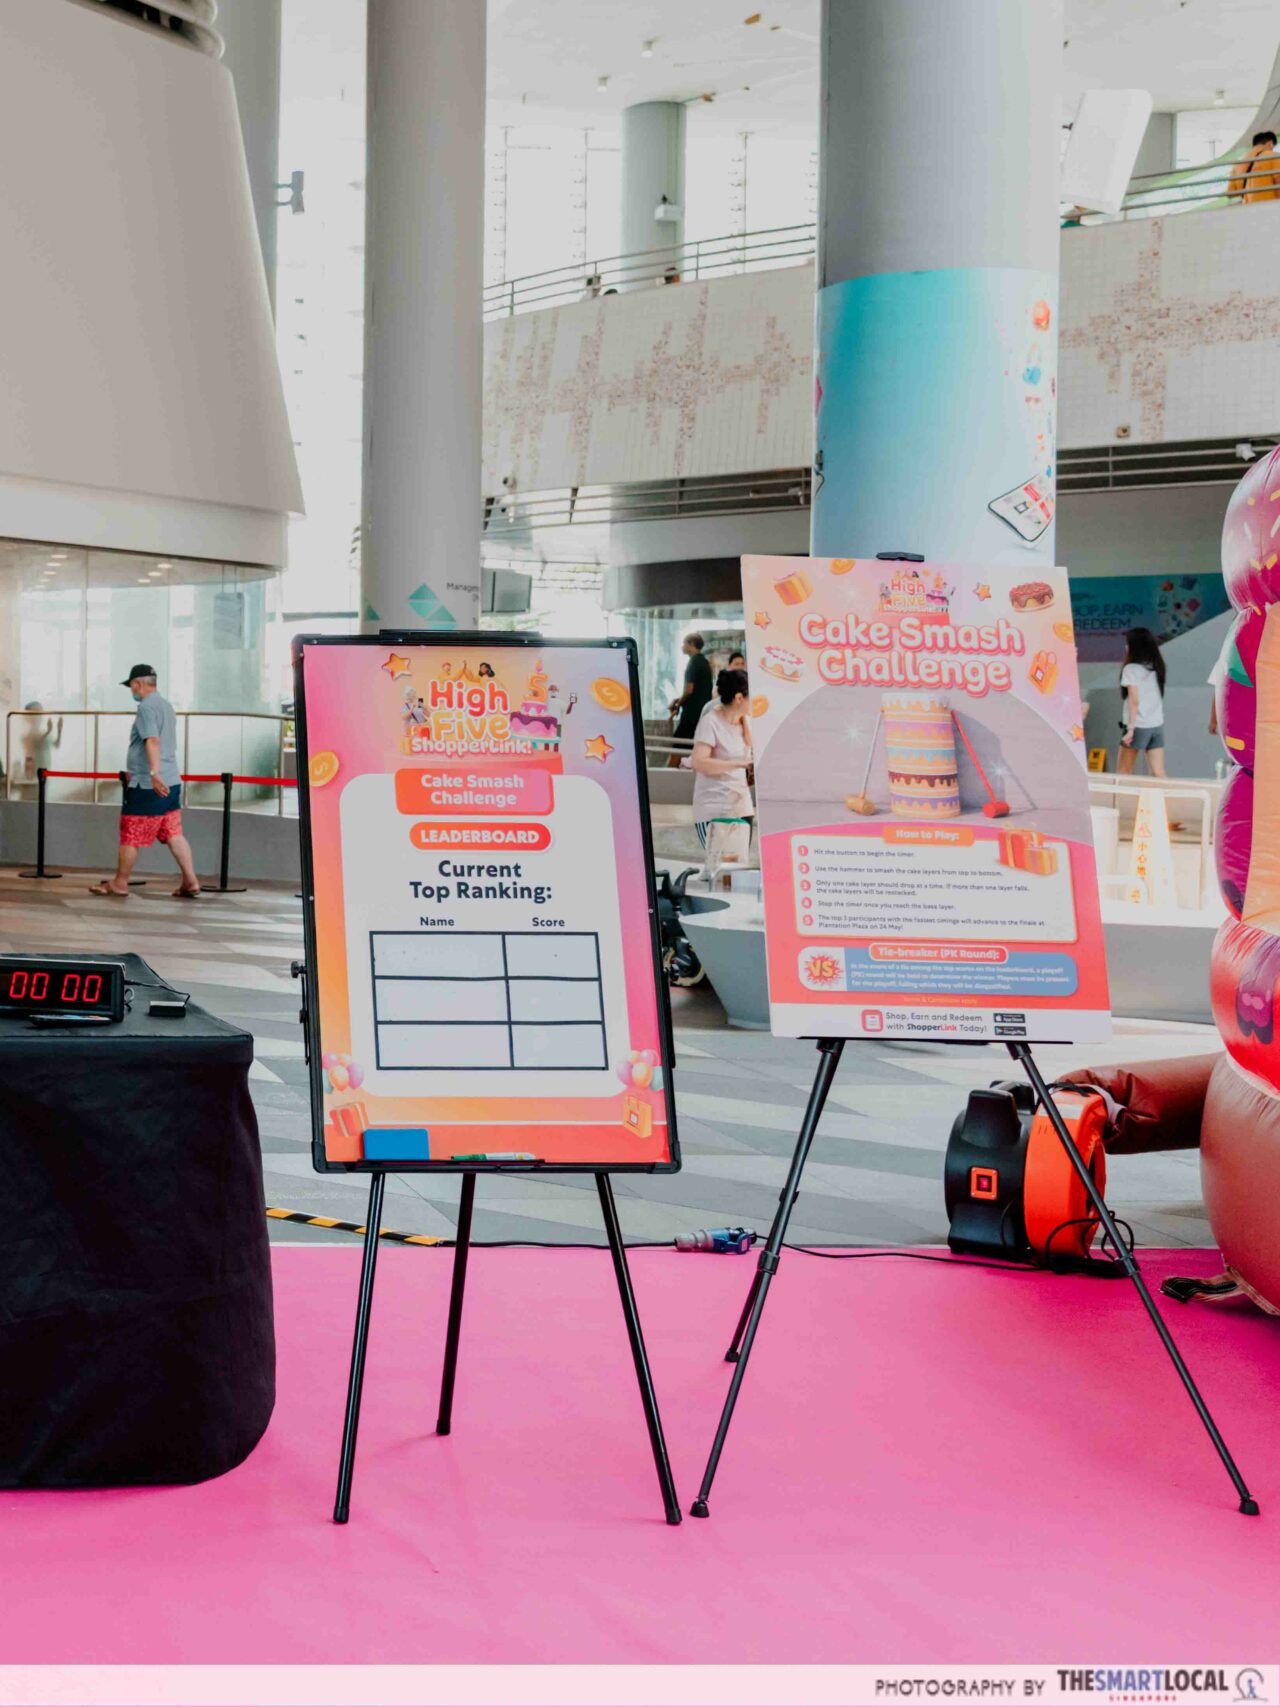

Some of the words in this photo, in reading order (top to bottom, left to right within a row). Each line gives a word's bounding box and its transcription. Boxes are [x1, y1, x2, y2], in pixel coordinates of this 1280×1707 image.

[891, 580, 926, 595] High
[1104, 604, 1144, 616] EARN
[800, 614, 890, 646] Cake
[899, 617, 1022, 652] Smash
[819, 650, 1010, 693] Challenge
[430, 680, 509, 717] High
[432, 711, 510, 741] Five
[411, 738, 532, 757] ShopperLink!
[421, 774, 463, 789] Cake
[467, 774, 524, 789] Smash
[430, 790, 517, 807] Challenge
[421, 829, 540, 844] LEADERBOARD
[895, 829, 919, 839] How
[921, 831, 932, 839] to
[438, 860, 522, 877] Current
[409, 881, 451, 903] Top
[456, 881, 553, 903] Ranking:
[420, 917, 455, 927] Name
[532, 917, 565, 927] Score
[808, 959, 833, 977] VS
[9, 971, 50, 999] 00
[61, 973, 102, 1002] 00
[911, 1012, 930, 1020] Earn
[931, 1013, 948, 1021] and
[949, 1014, 983, 1022] Redeem
[887, 1023, 905, 1031] with
[907, 1023, 957, 1032] ShopperLink
[959, 1024, 987, 1034] Today!
